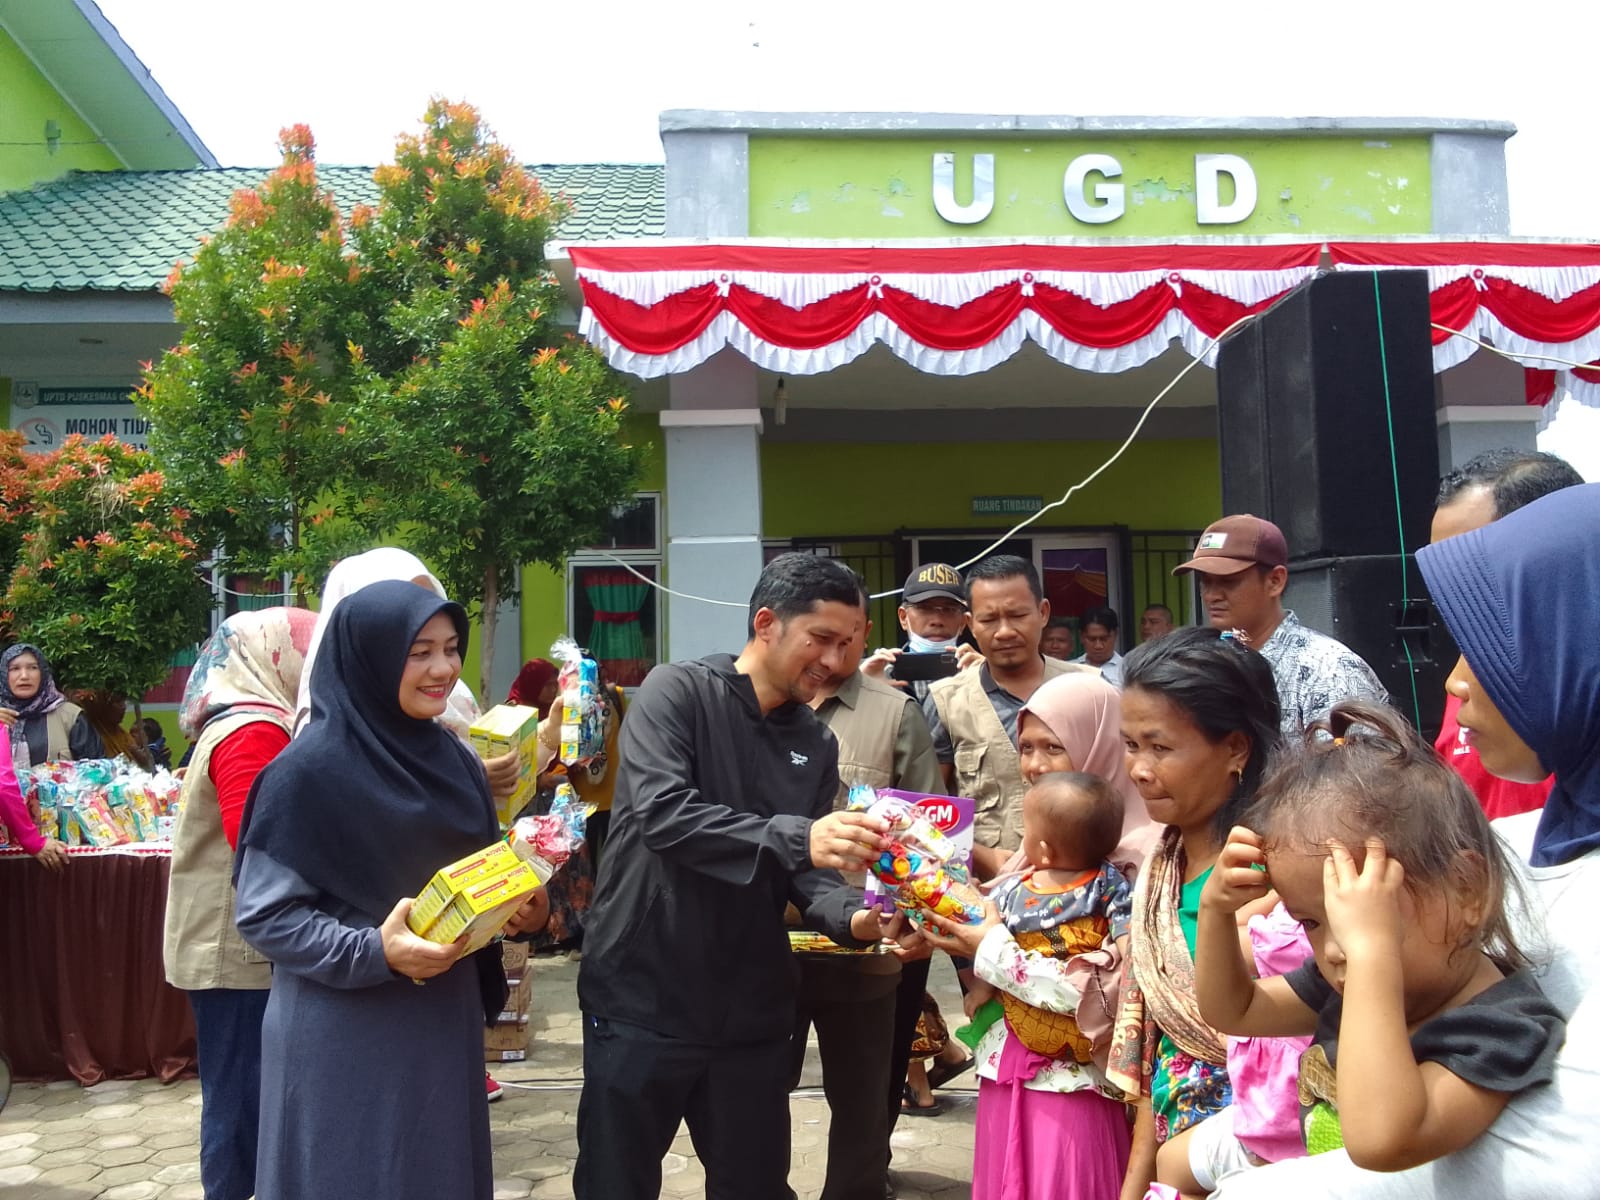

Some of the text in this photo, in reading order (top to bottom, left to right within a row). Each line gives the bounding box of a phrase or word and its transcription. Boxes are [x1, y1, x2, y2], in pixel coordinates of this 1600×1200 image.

[67, 391, 118, 402] PUSKESMAS
[66, 418, 151, 435] MOHON TIDA
[972, 499, 1042, 512] RUANG TINDAKAN
